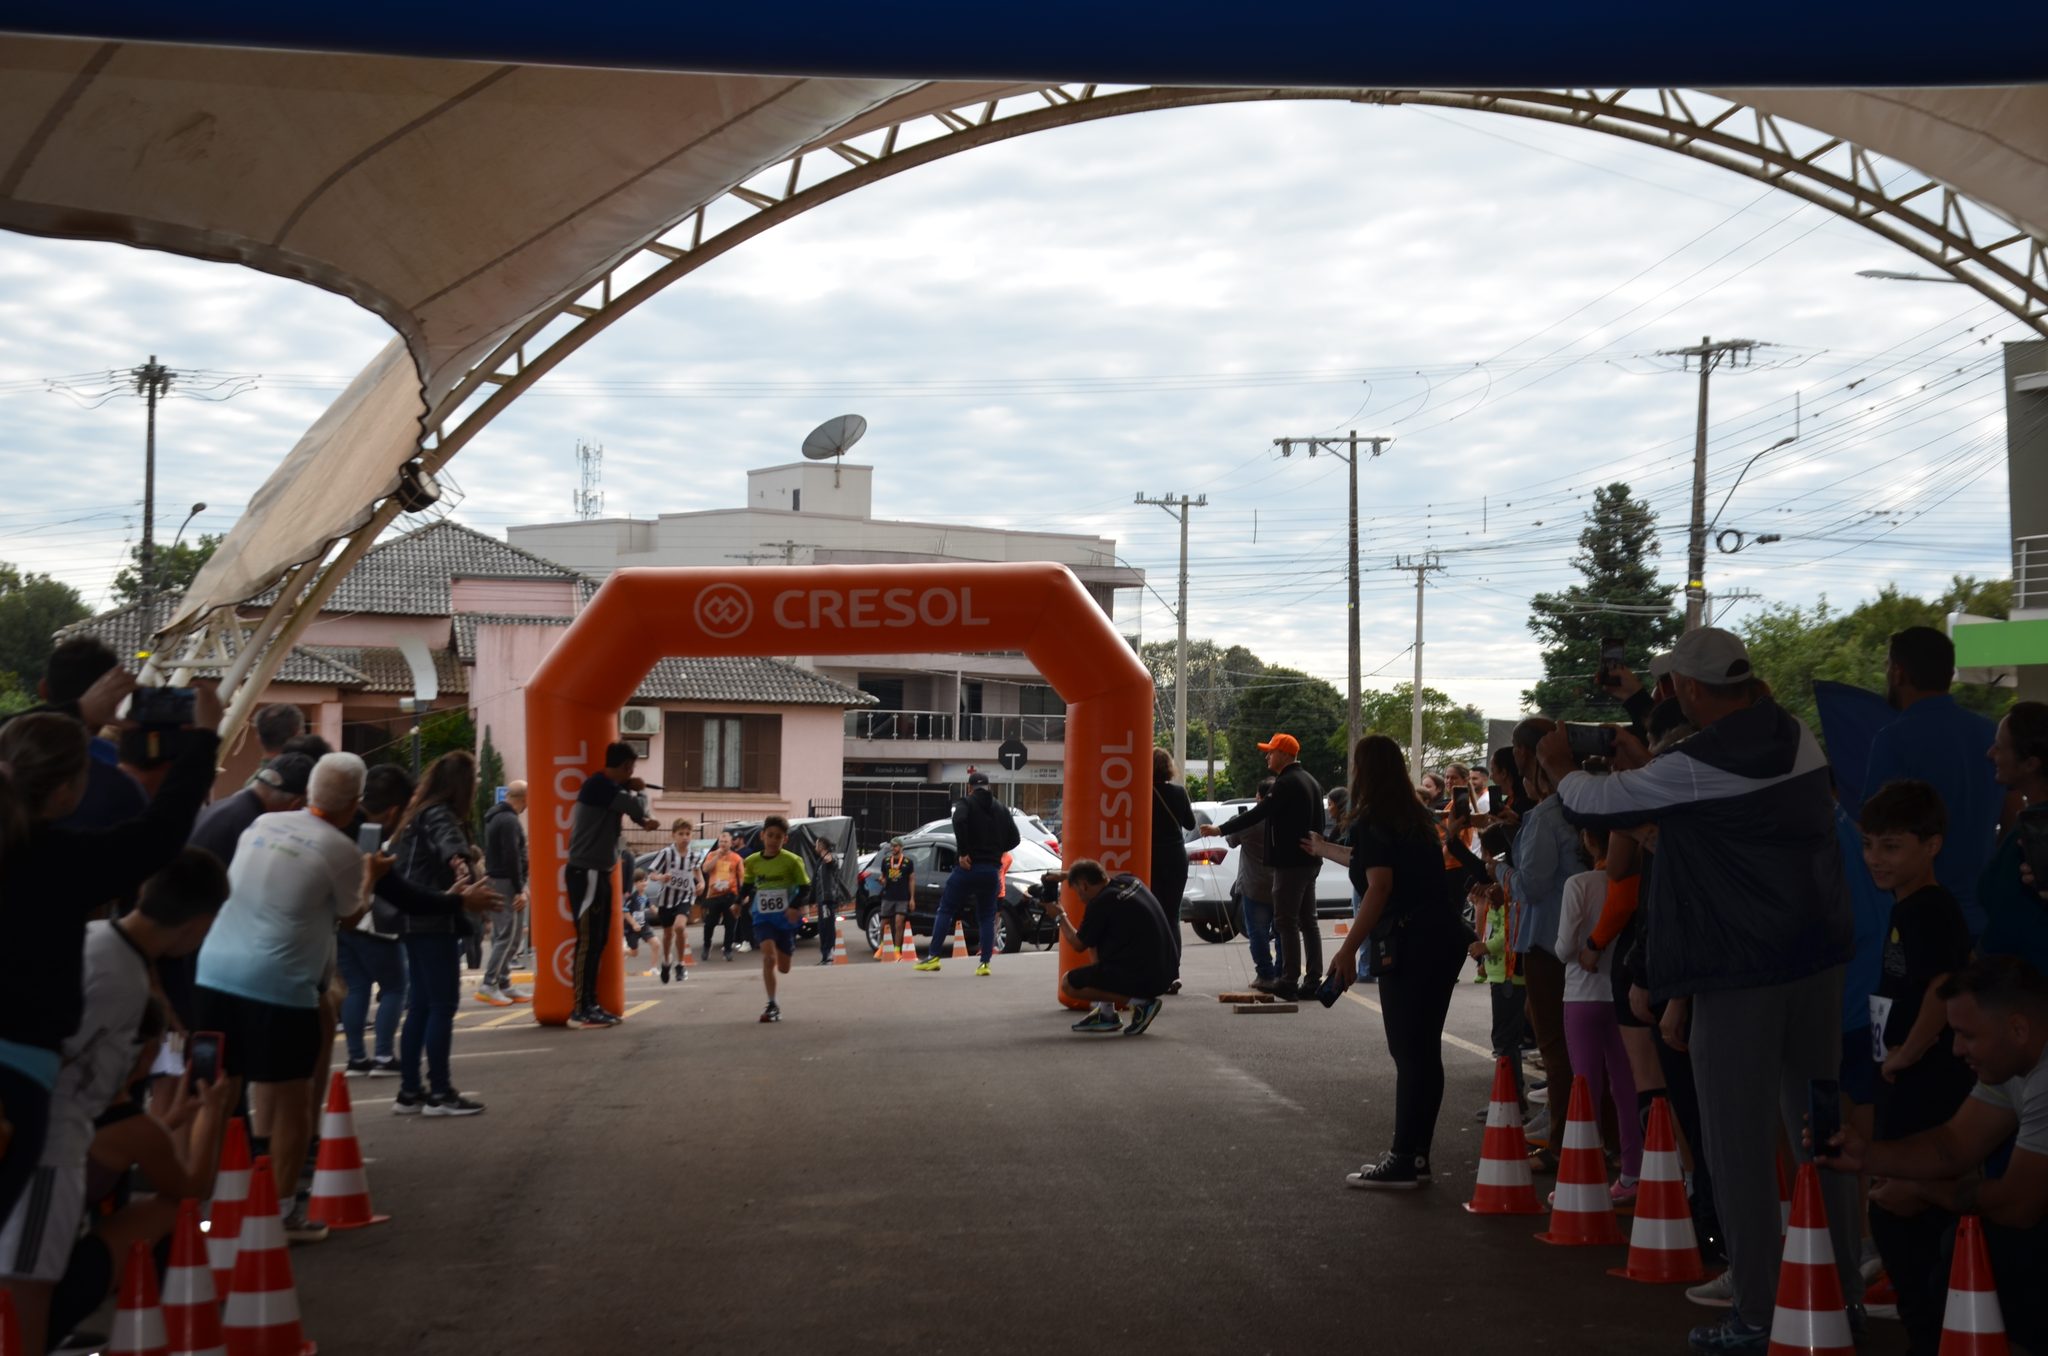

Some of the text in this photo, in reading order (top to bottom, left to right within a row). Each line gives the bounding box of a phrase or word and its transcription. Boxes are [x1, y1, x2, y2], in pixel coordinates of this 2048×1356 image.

[773, 587, 990, 629] CRESOL
[1100, 730, 1133, 875] RESOL
[553, 740, 588, 922] SOL
[671, 876, 689, 889] 990
[760, 897, 784, 911] 968
